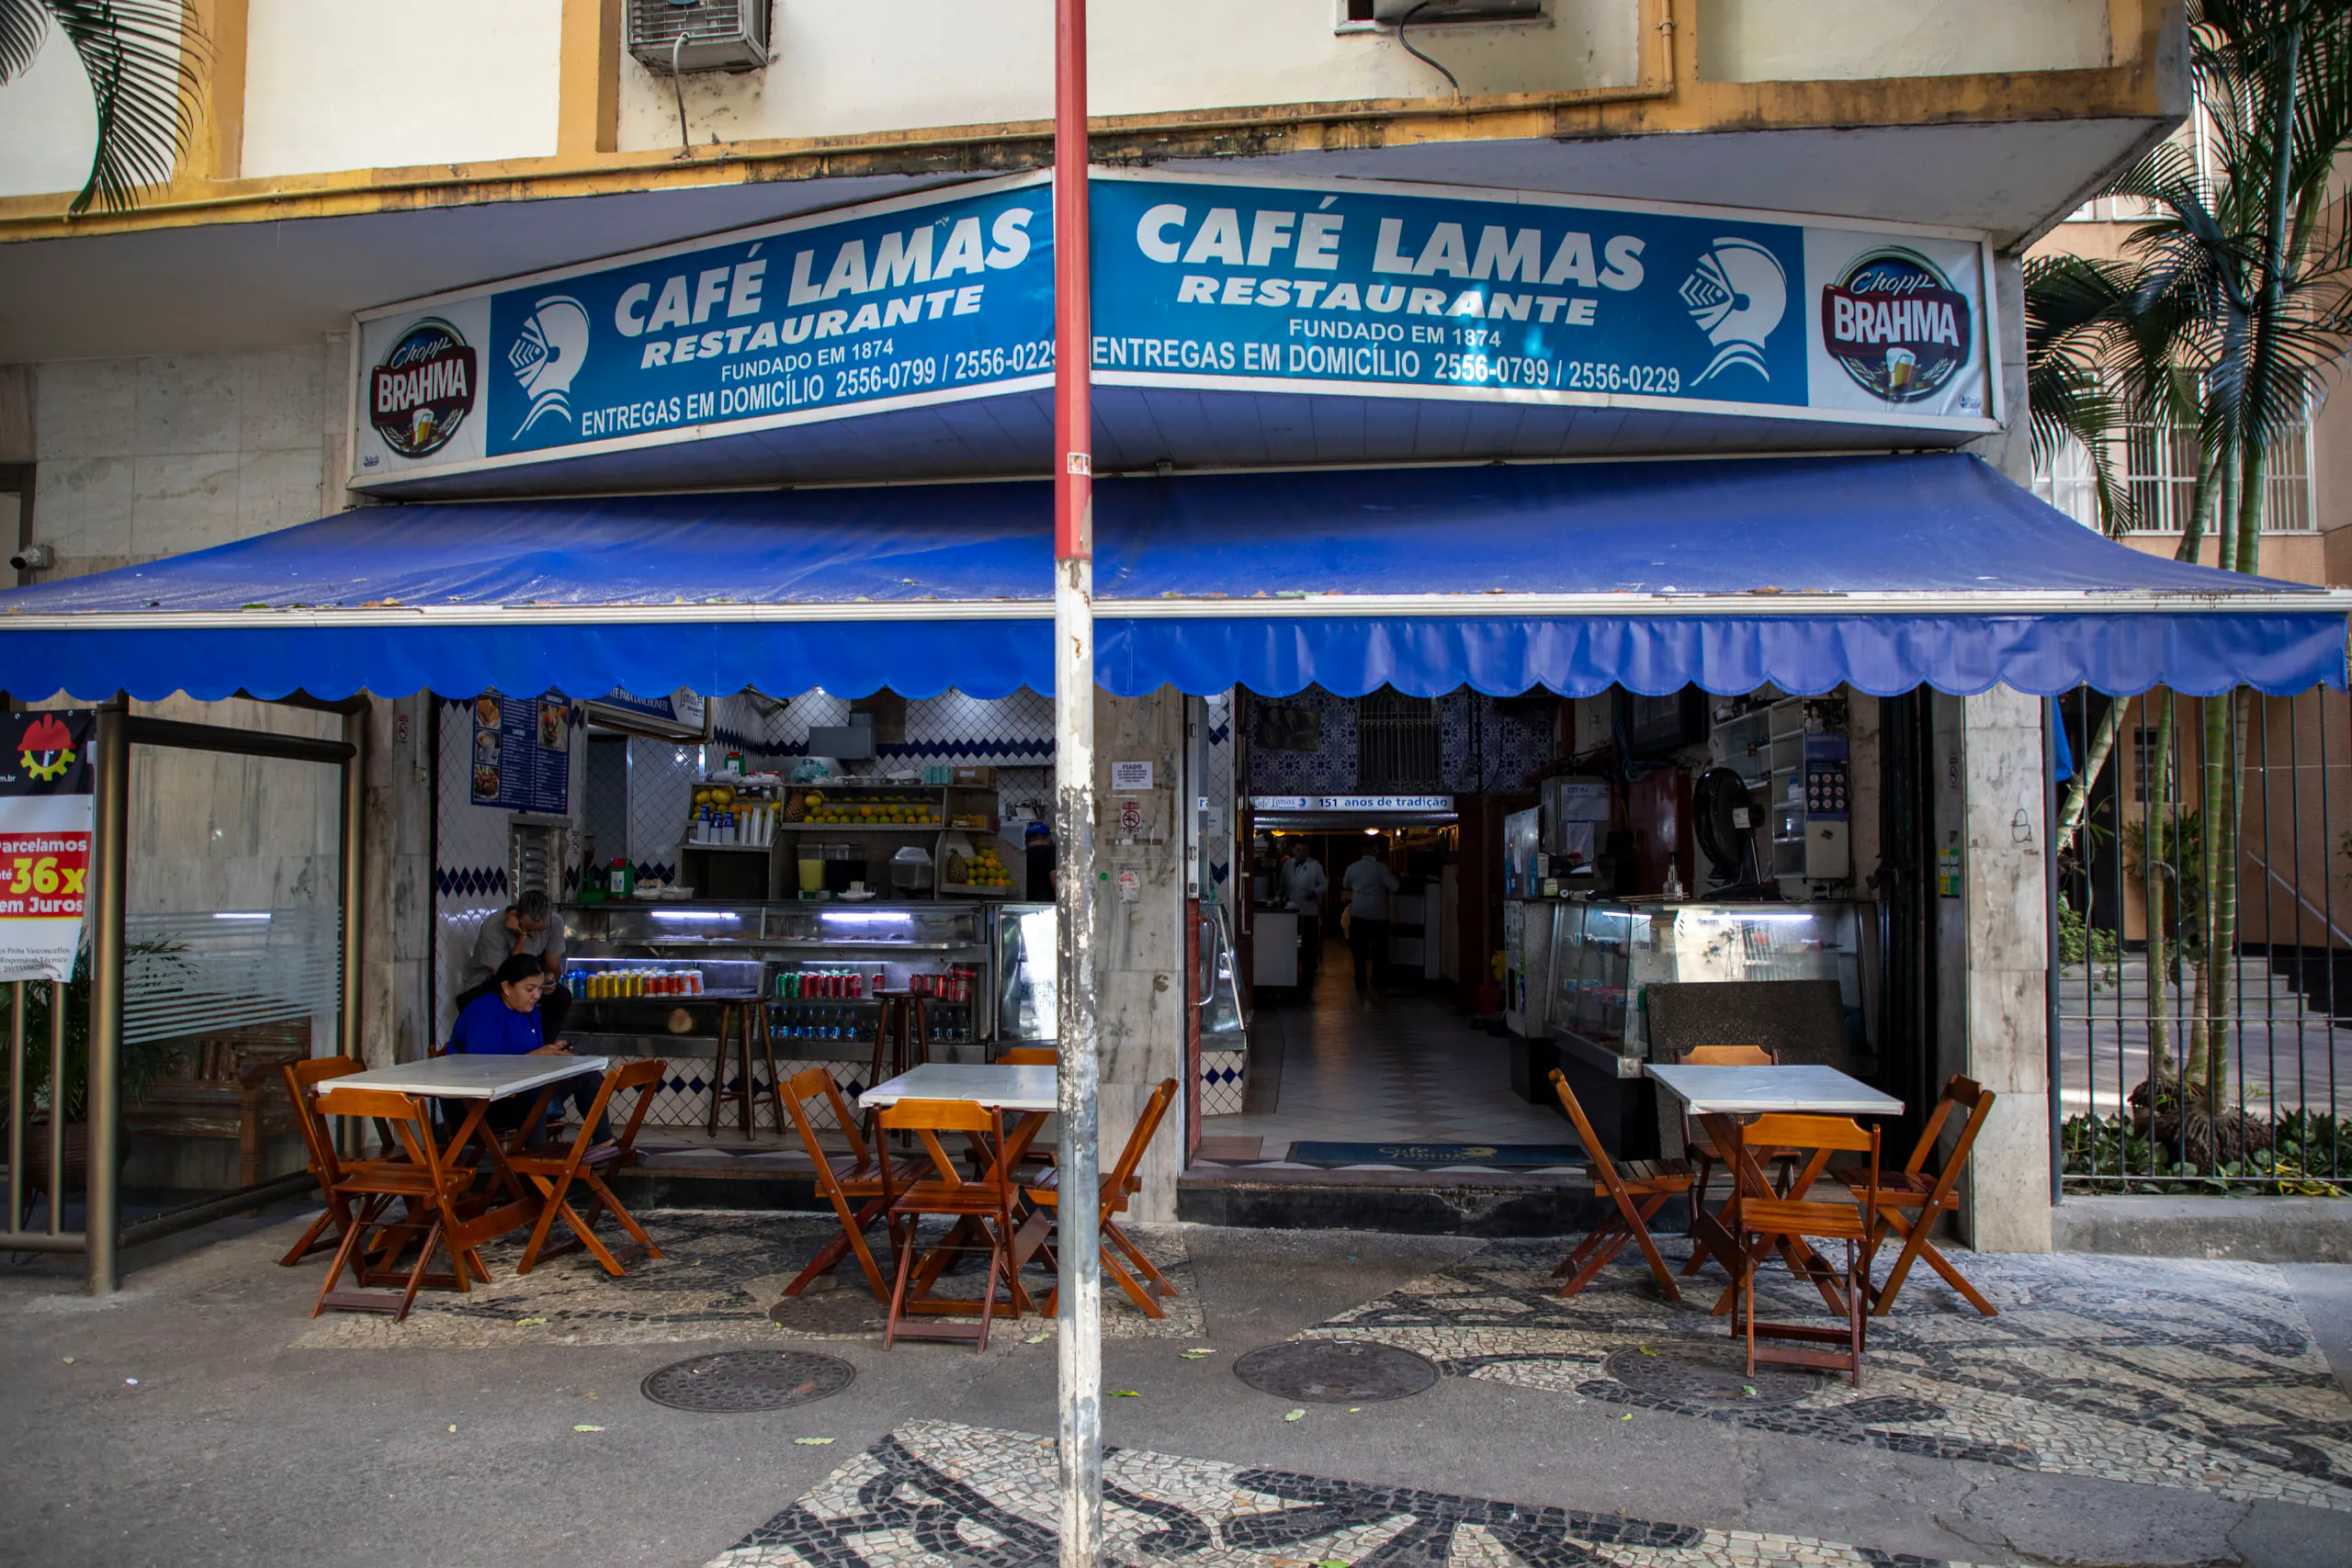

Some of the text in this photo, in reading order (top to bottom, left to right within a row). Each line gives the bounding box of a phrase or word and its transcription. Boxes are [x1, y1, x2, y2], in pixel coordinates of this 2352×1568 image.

[1136, 196, 1646, 291] CAFÉ LAMAS
[615, 208, 1034, 338] CAFÉ LAMAS
[1850, 271, 1936, 297] Chopp
[1177, 275, 1598, 326] RESTAURANTE
[1834, 295, 1960, 347] BRAHMA
[640, 285, 985, 369] RESTAURANTE
[1290, 319, 1501, 347] FUNDADO EM 1874
[390, 337, 453, 369] Chopp
[721, 338, 894, 382] FUNDADO EM 1874
[1092, 336, 1680, 393] ENTREGAS EM DOMICÍLIO 2556-0799 / 2556-0229
[379, 359, 468, 412] BRAHMA
[582, 397, 681, 436] ENTREGAS
[687, 391, 714, 420] EM
[720, 374, 824, 414] DOMICÍLIO
[836, 356, 936, 398] 2556-0799
[942, 354, 949, 381] /
[1318, 797, 1448, 809] 151 anos de tradição
[0, 838, 87, 853] arcelamos
[0, 856, 86, 895] té 36x
[28, 897, 84, 914] Juros
